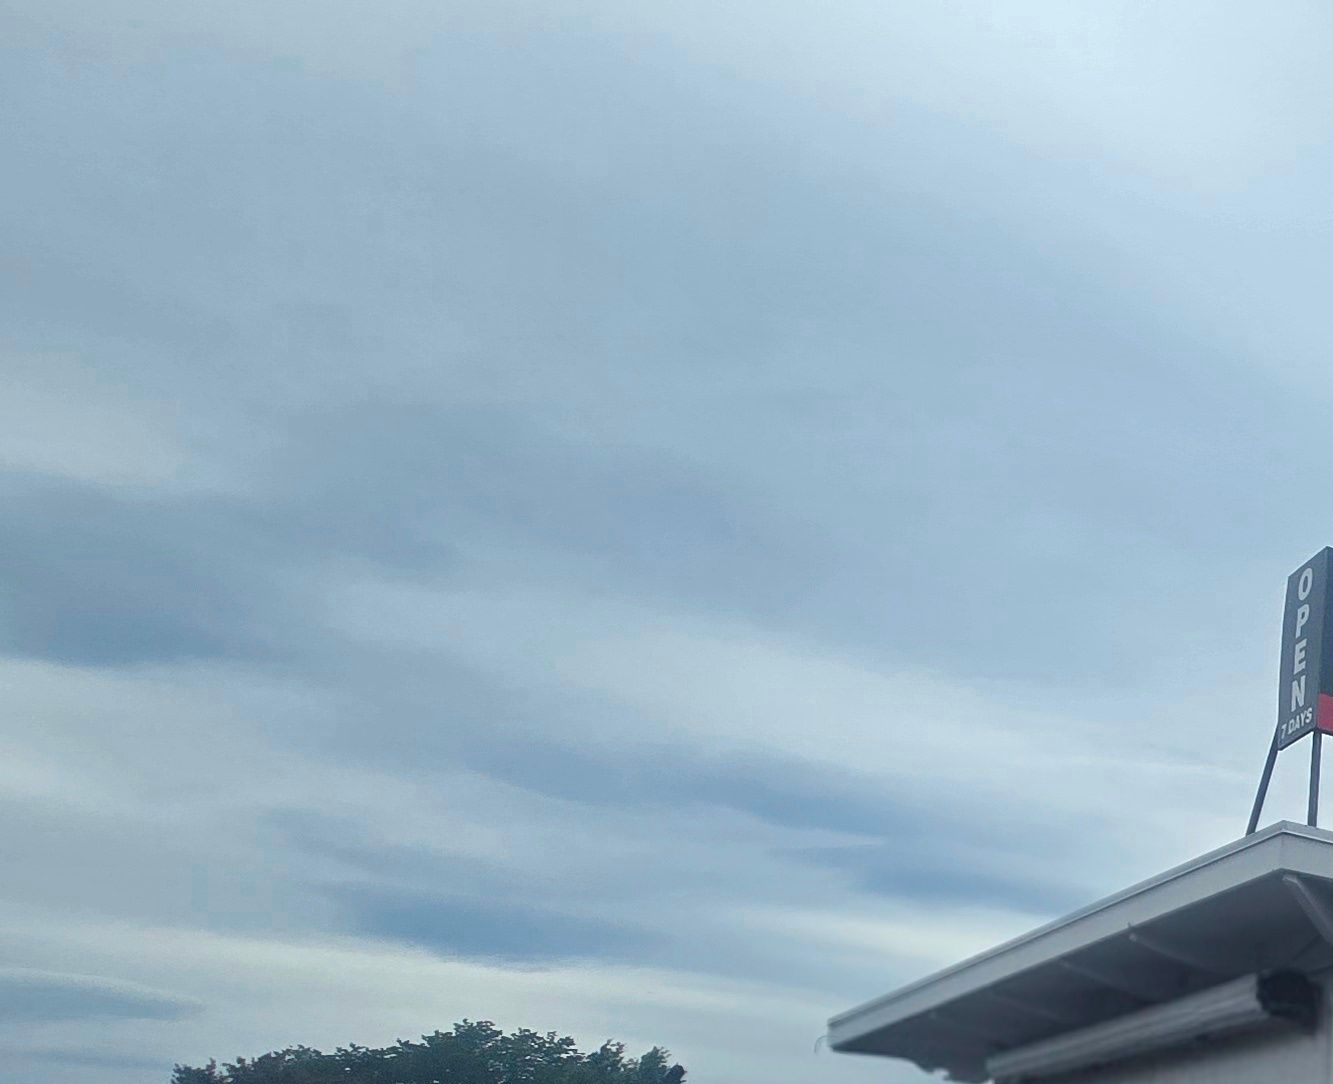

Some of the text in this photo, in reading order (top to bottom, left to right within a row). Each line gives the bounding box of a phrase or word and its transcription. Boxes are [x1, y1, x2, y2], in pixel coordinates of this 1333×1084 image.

[1291, 567, 1313, 713] OPEN
[1281, 707, 1313, 739] 7 DAYS
